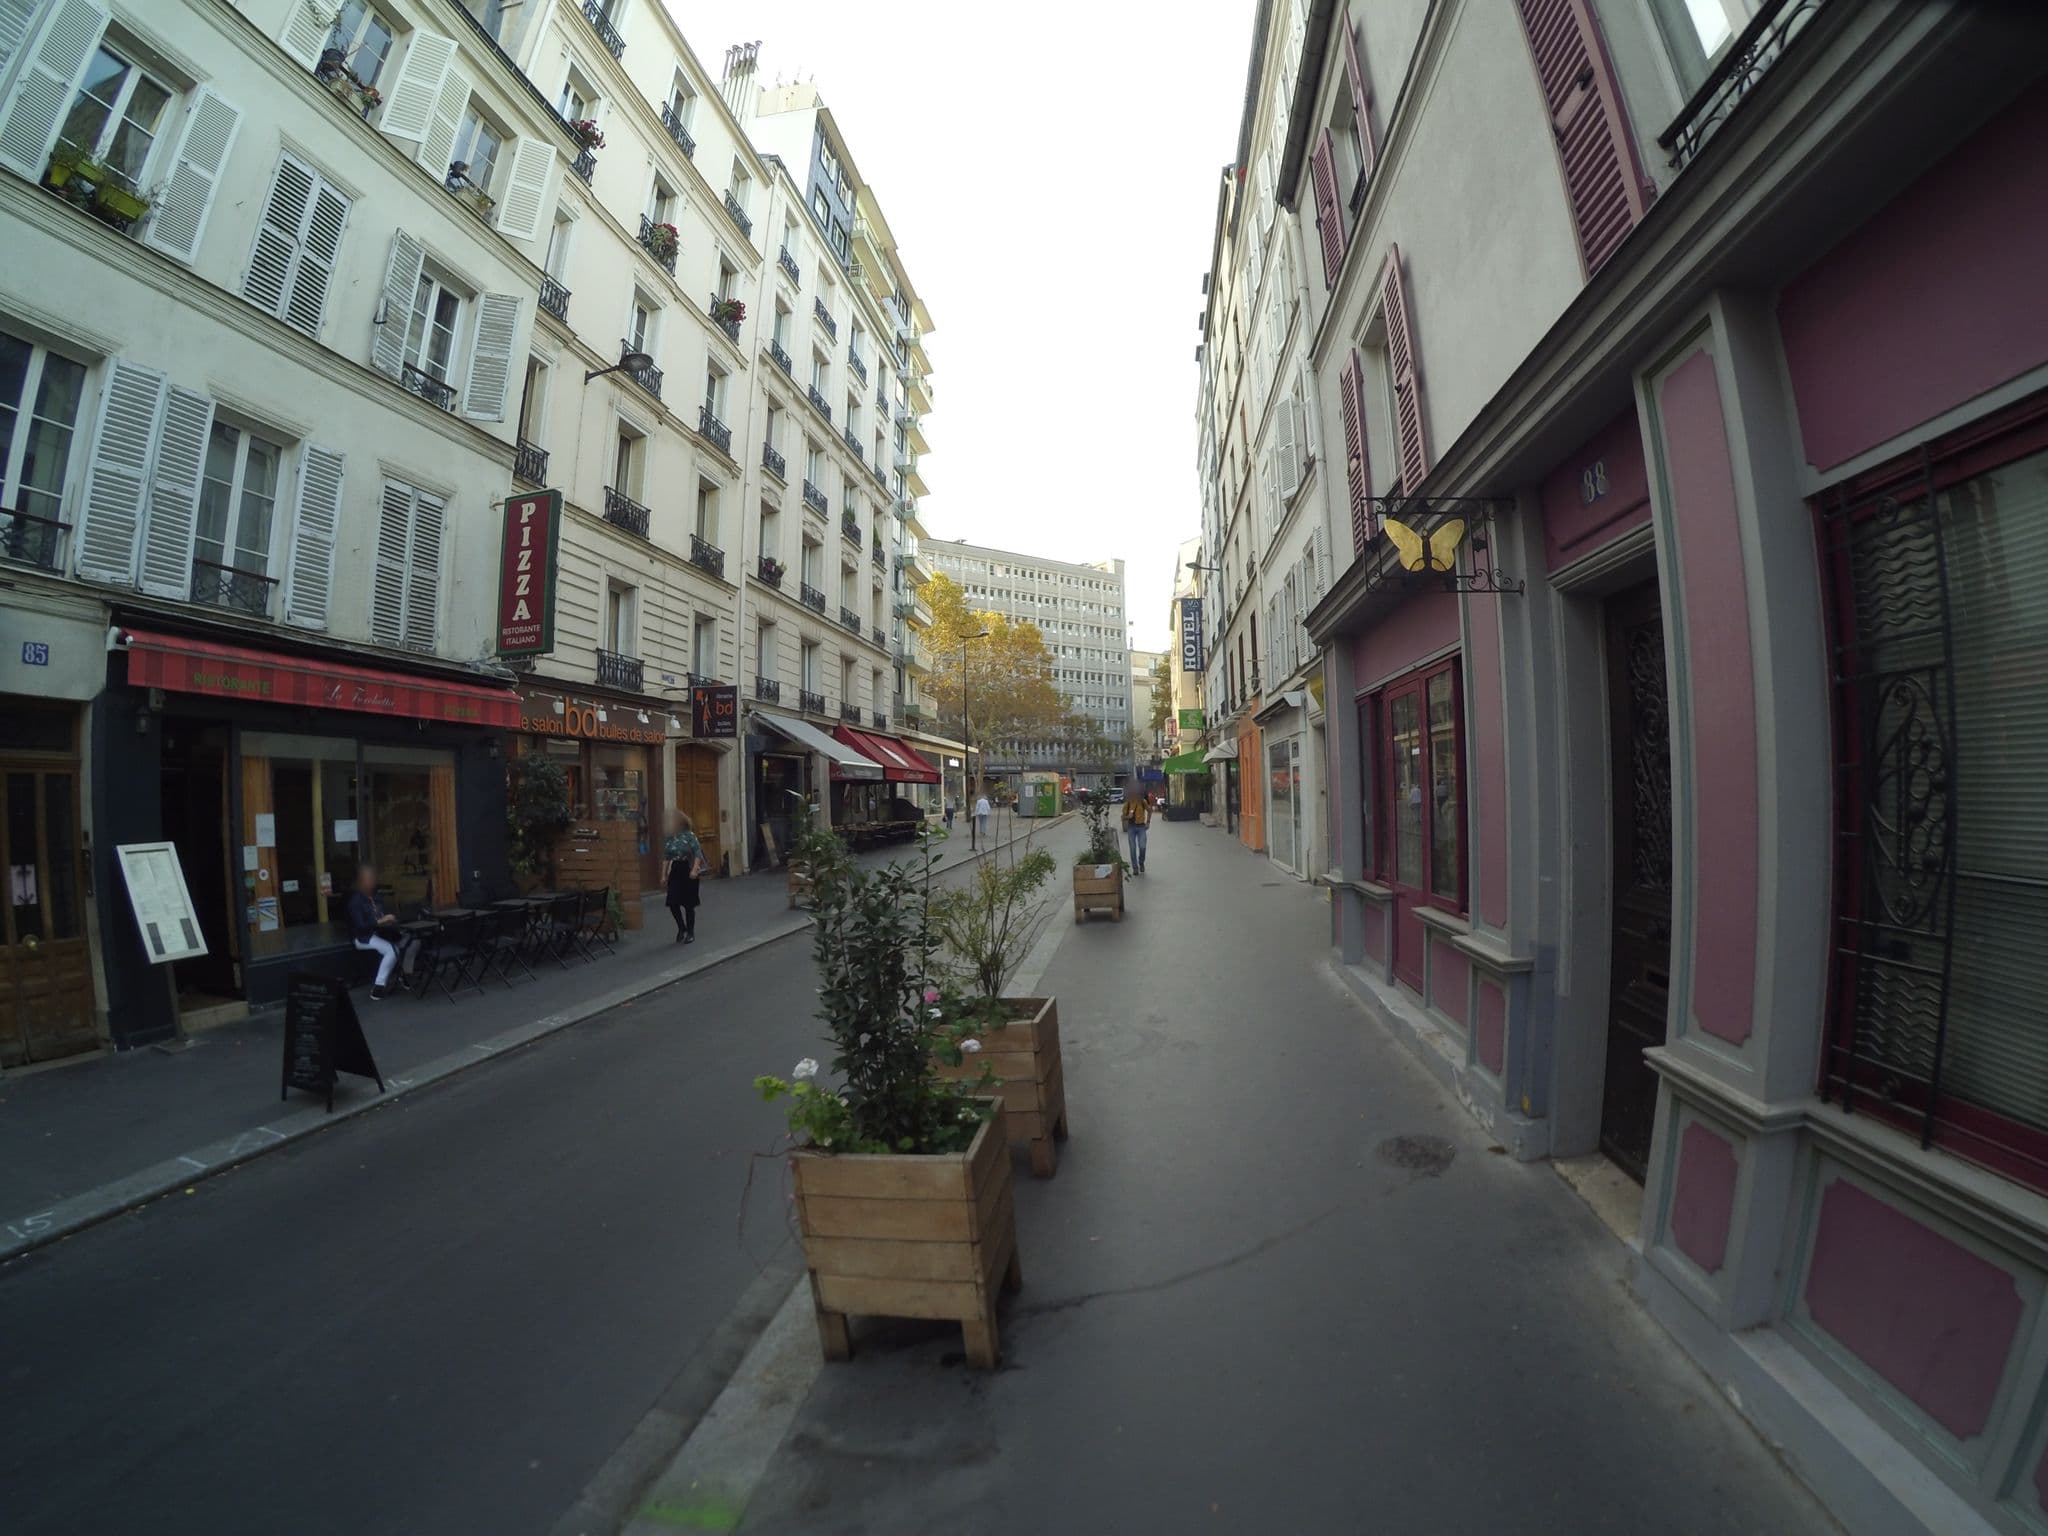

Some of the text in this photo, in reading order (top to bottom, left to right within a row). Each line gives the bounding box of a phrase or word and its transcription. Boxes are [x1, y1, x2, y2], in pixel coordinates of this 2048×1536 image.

[1584, 461, 1607, 502] 88
[512, 502, 537, 622] PIZZA
[502, 624, 542, 636] RISTORANTE
[505, 635, 537, 646] ITALIANO
[1183, 612, 1197, 670] HOTEL
[25, 643, 47, 664] 85
[565, 695, 598, 738] bd
[716, 701, 733, 716] bd
[532, 713, 563, 735] salon
[600, 720, 665, 746] bulles de salon
